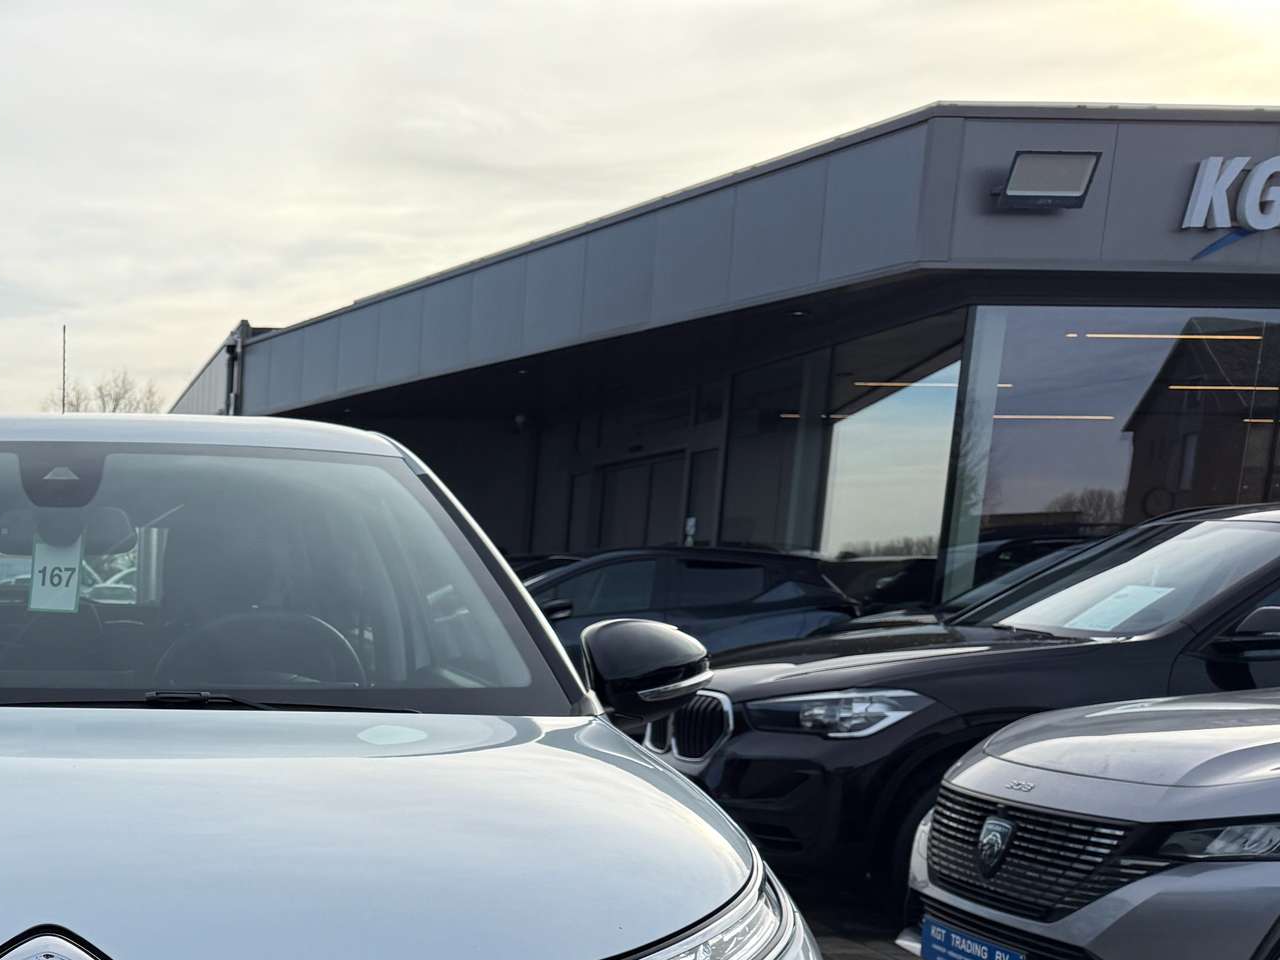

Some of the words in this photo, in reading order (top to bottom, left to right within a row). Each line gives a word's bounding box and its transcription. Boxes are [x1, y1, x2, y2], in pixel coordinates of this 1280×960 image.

[37, 566, 76, 588] 167
[930, 925, 946, 942] KGT
[950, 933, 989, 960] TRADING
